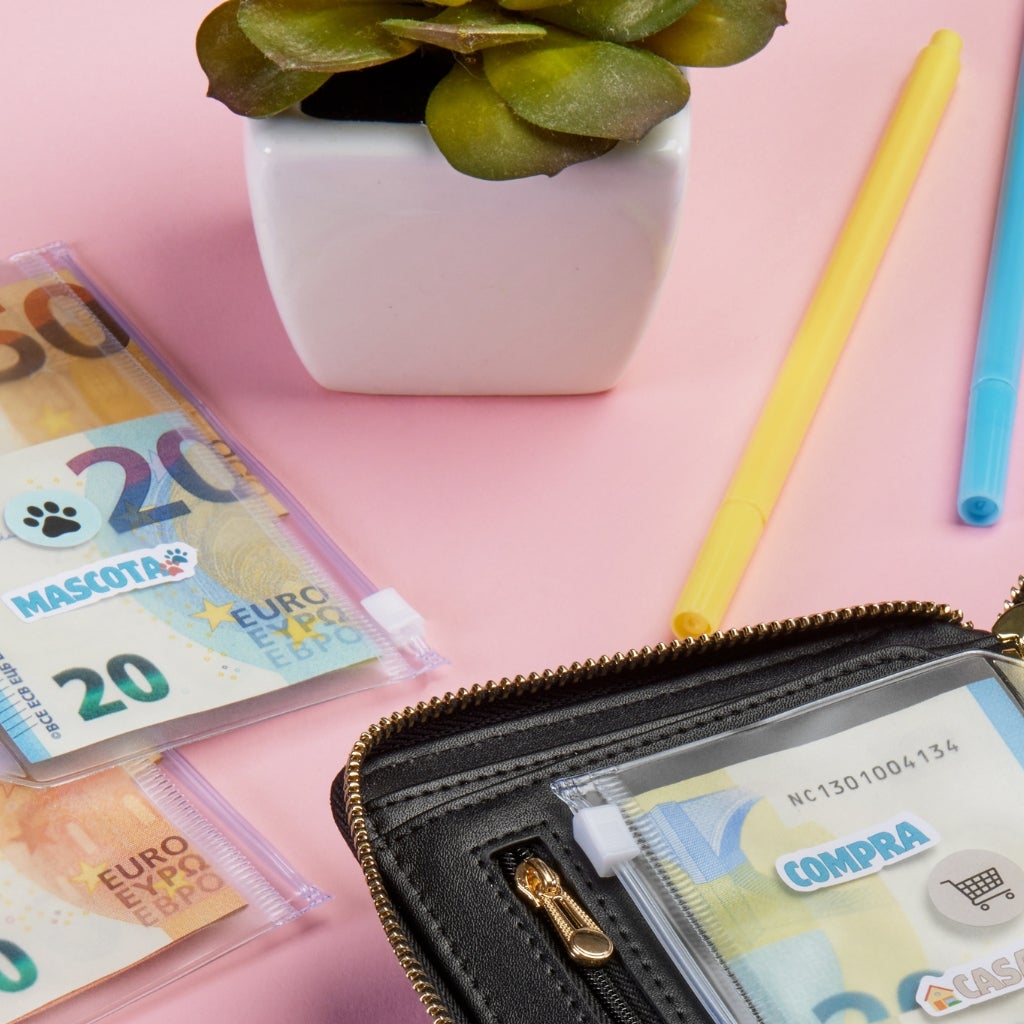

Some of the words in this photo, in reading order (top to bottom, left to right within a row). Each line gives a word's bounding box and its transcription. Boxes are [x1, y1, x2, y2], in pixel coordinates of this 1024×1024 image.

[66, 429, 250, 535] 20
[11, 556, 168, 619] MASCOTA
[231, 586, 330, 629] EURO
[52, 653, 170, 722] 20
[787, 738, 960, 807] NC1301004134
[97, 835, 189, 891] EURO
[784, 821, 930, 888] COMPRA
